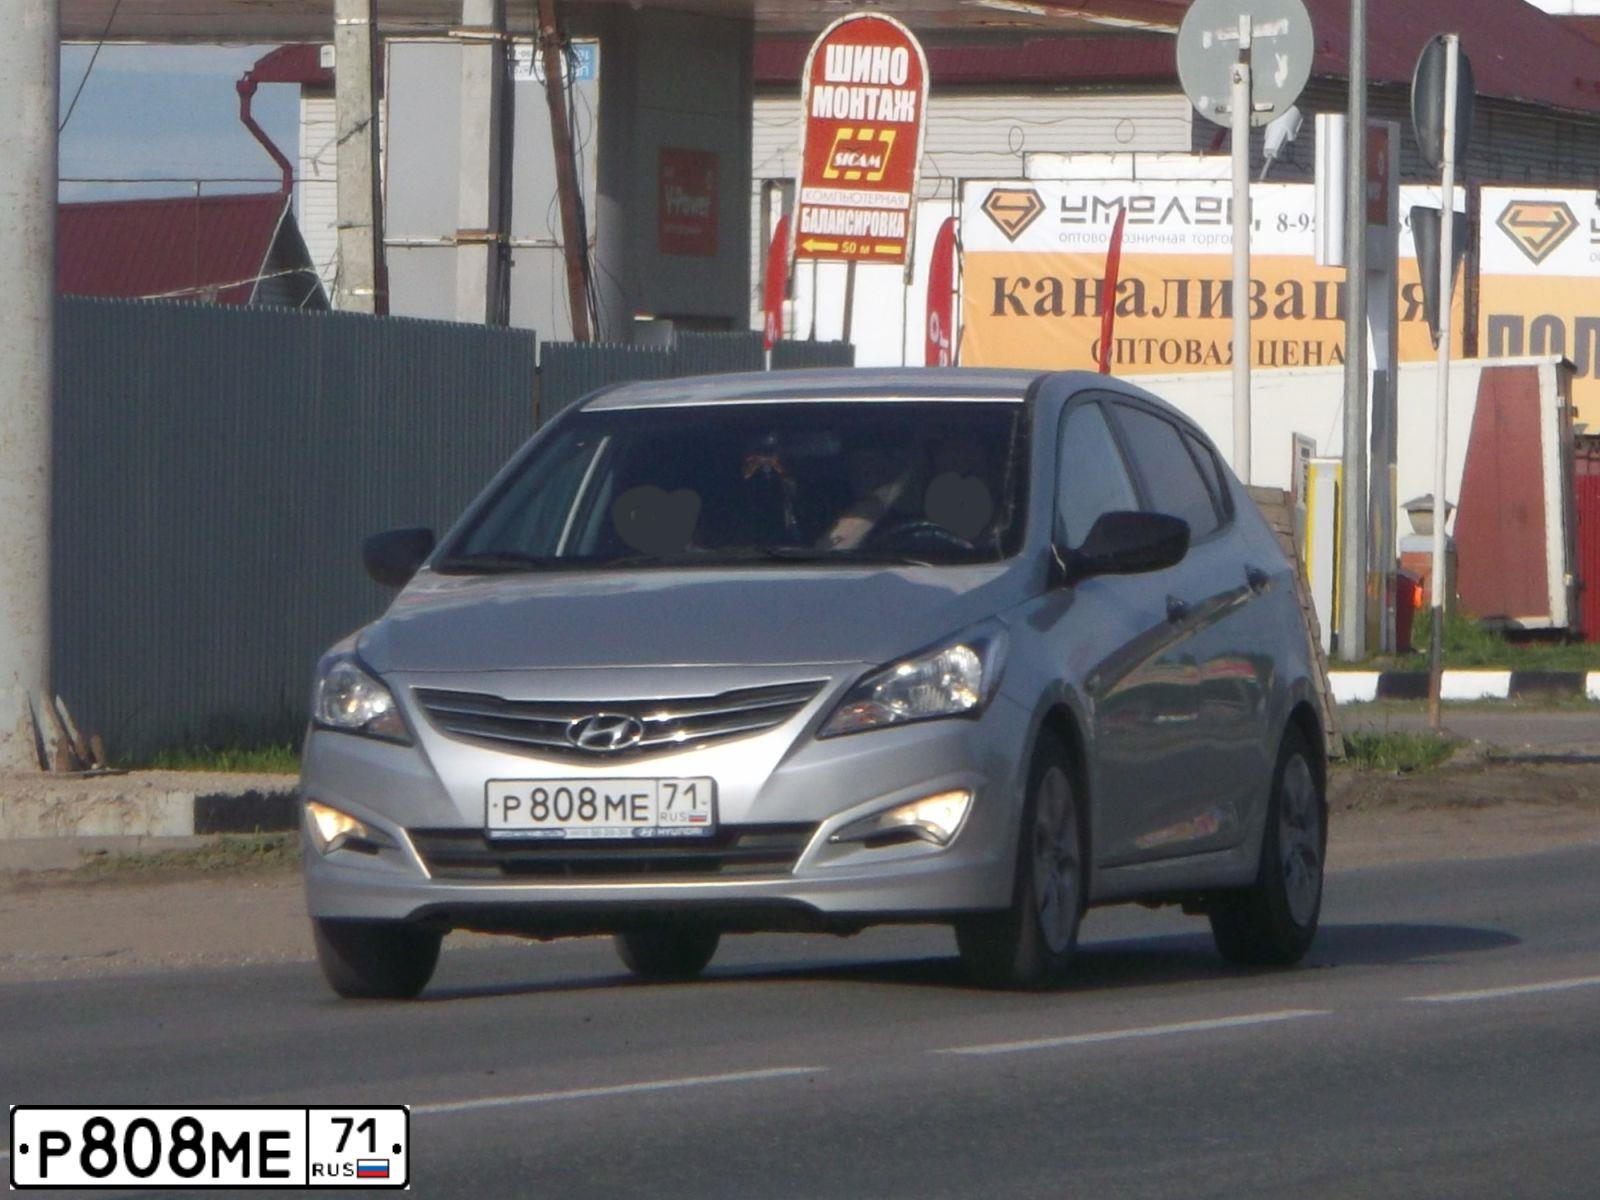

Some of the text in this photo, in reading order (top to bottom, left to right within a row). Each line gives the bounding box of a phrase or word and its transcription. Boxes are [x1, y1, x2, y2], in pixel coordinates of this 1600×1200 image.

[825, 44, 909, 86] ШИНО
[812, 85, 917, 122] МОНТАЖ
[804, 189, 906, 206] КОМПЬЮТЕРНАЯ
[800, 206, 906, 238] БАЛАНСИРОВКА
[841, 241, 857, 254] 50
[1257, 339, 1346, 367] ЦЕНА
[503, 783, 698, 822] Р808МЕ 71
[660, 811, 687, 823] RUS
